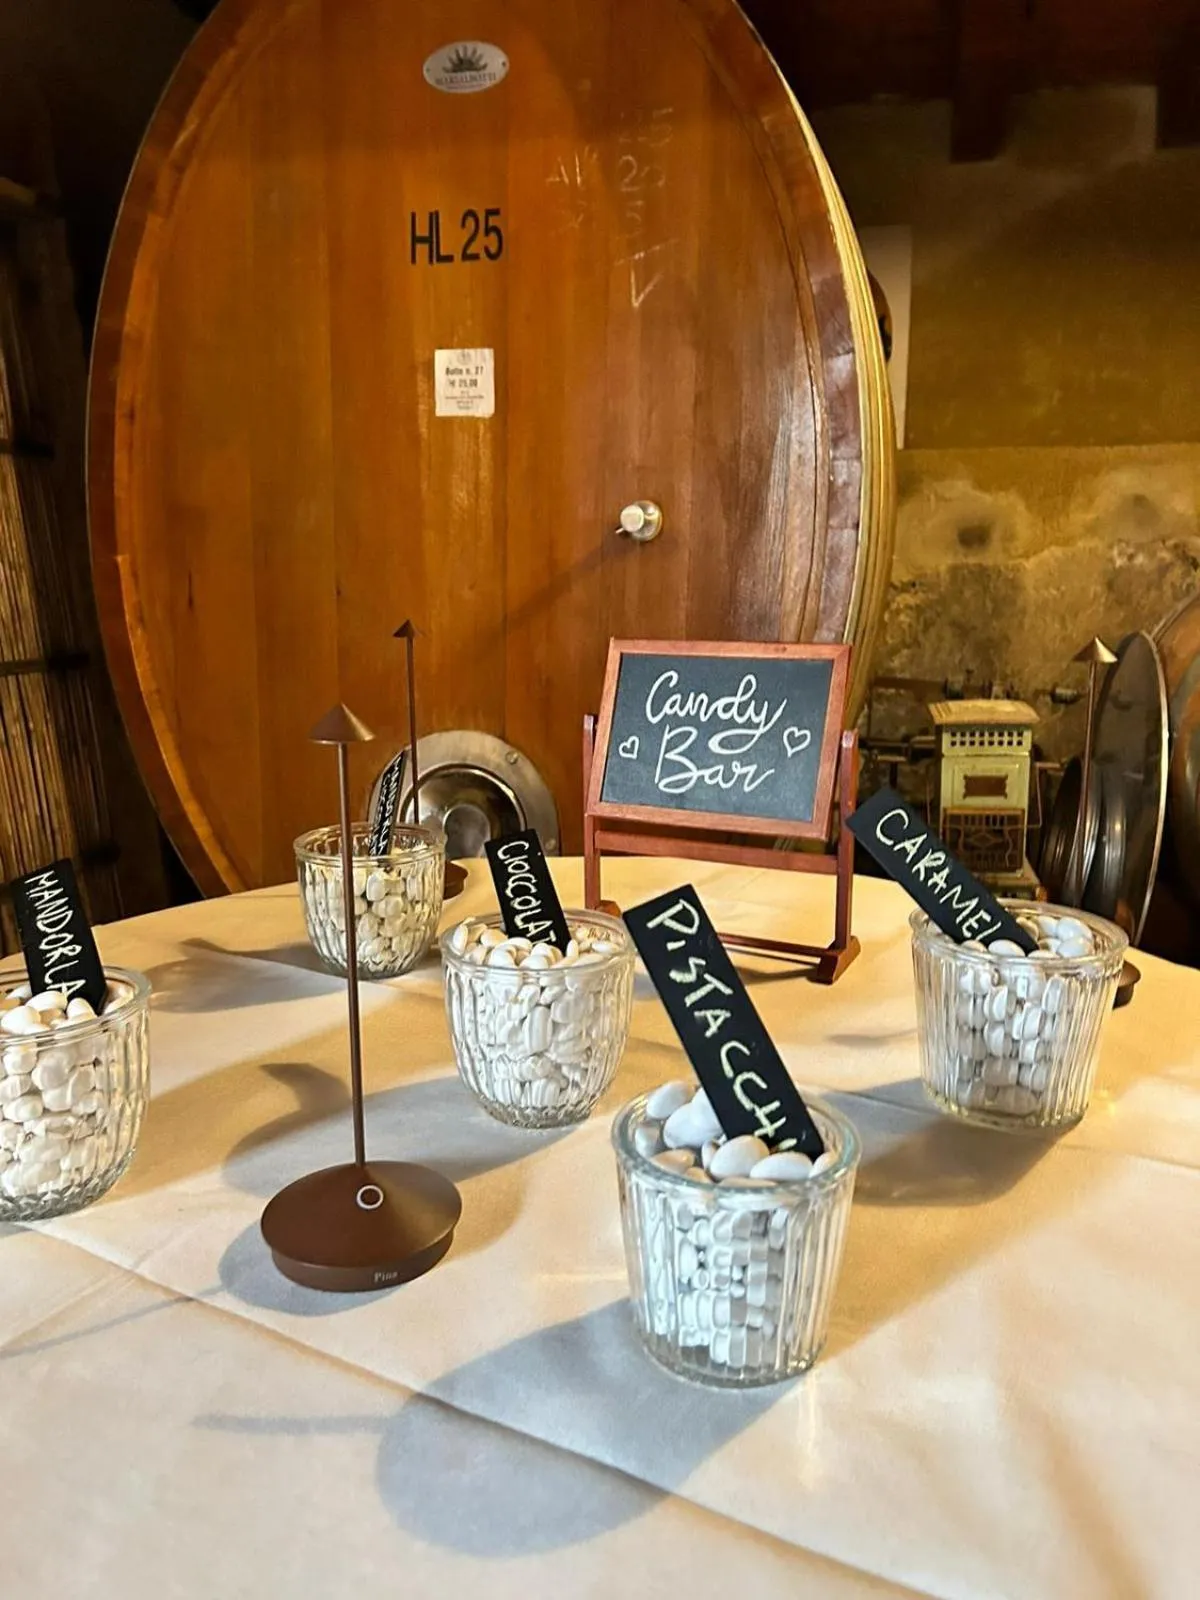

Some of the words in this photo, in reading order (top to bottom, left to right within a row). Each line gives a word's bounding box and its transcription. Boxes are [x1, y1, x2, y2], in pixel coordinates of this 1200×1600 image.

[411, 209, 454, 265] HL
[460, 207, 504, 261] 25
[645, 669, 788, 755] Candy
[654, 724, 776, 794] Bar
[24, 870, 87, 998] MANDORLA
